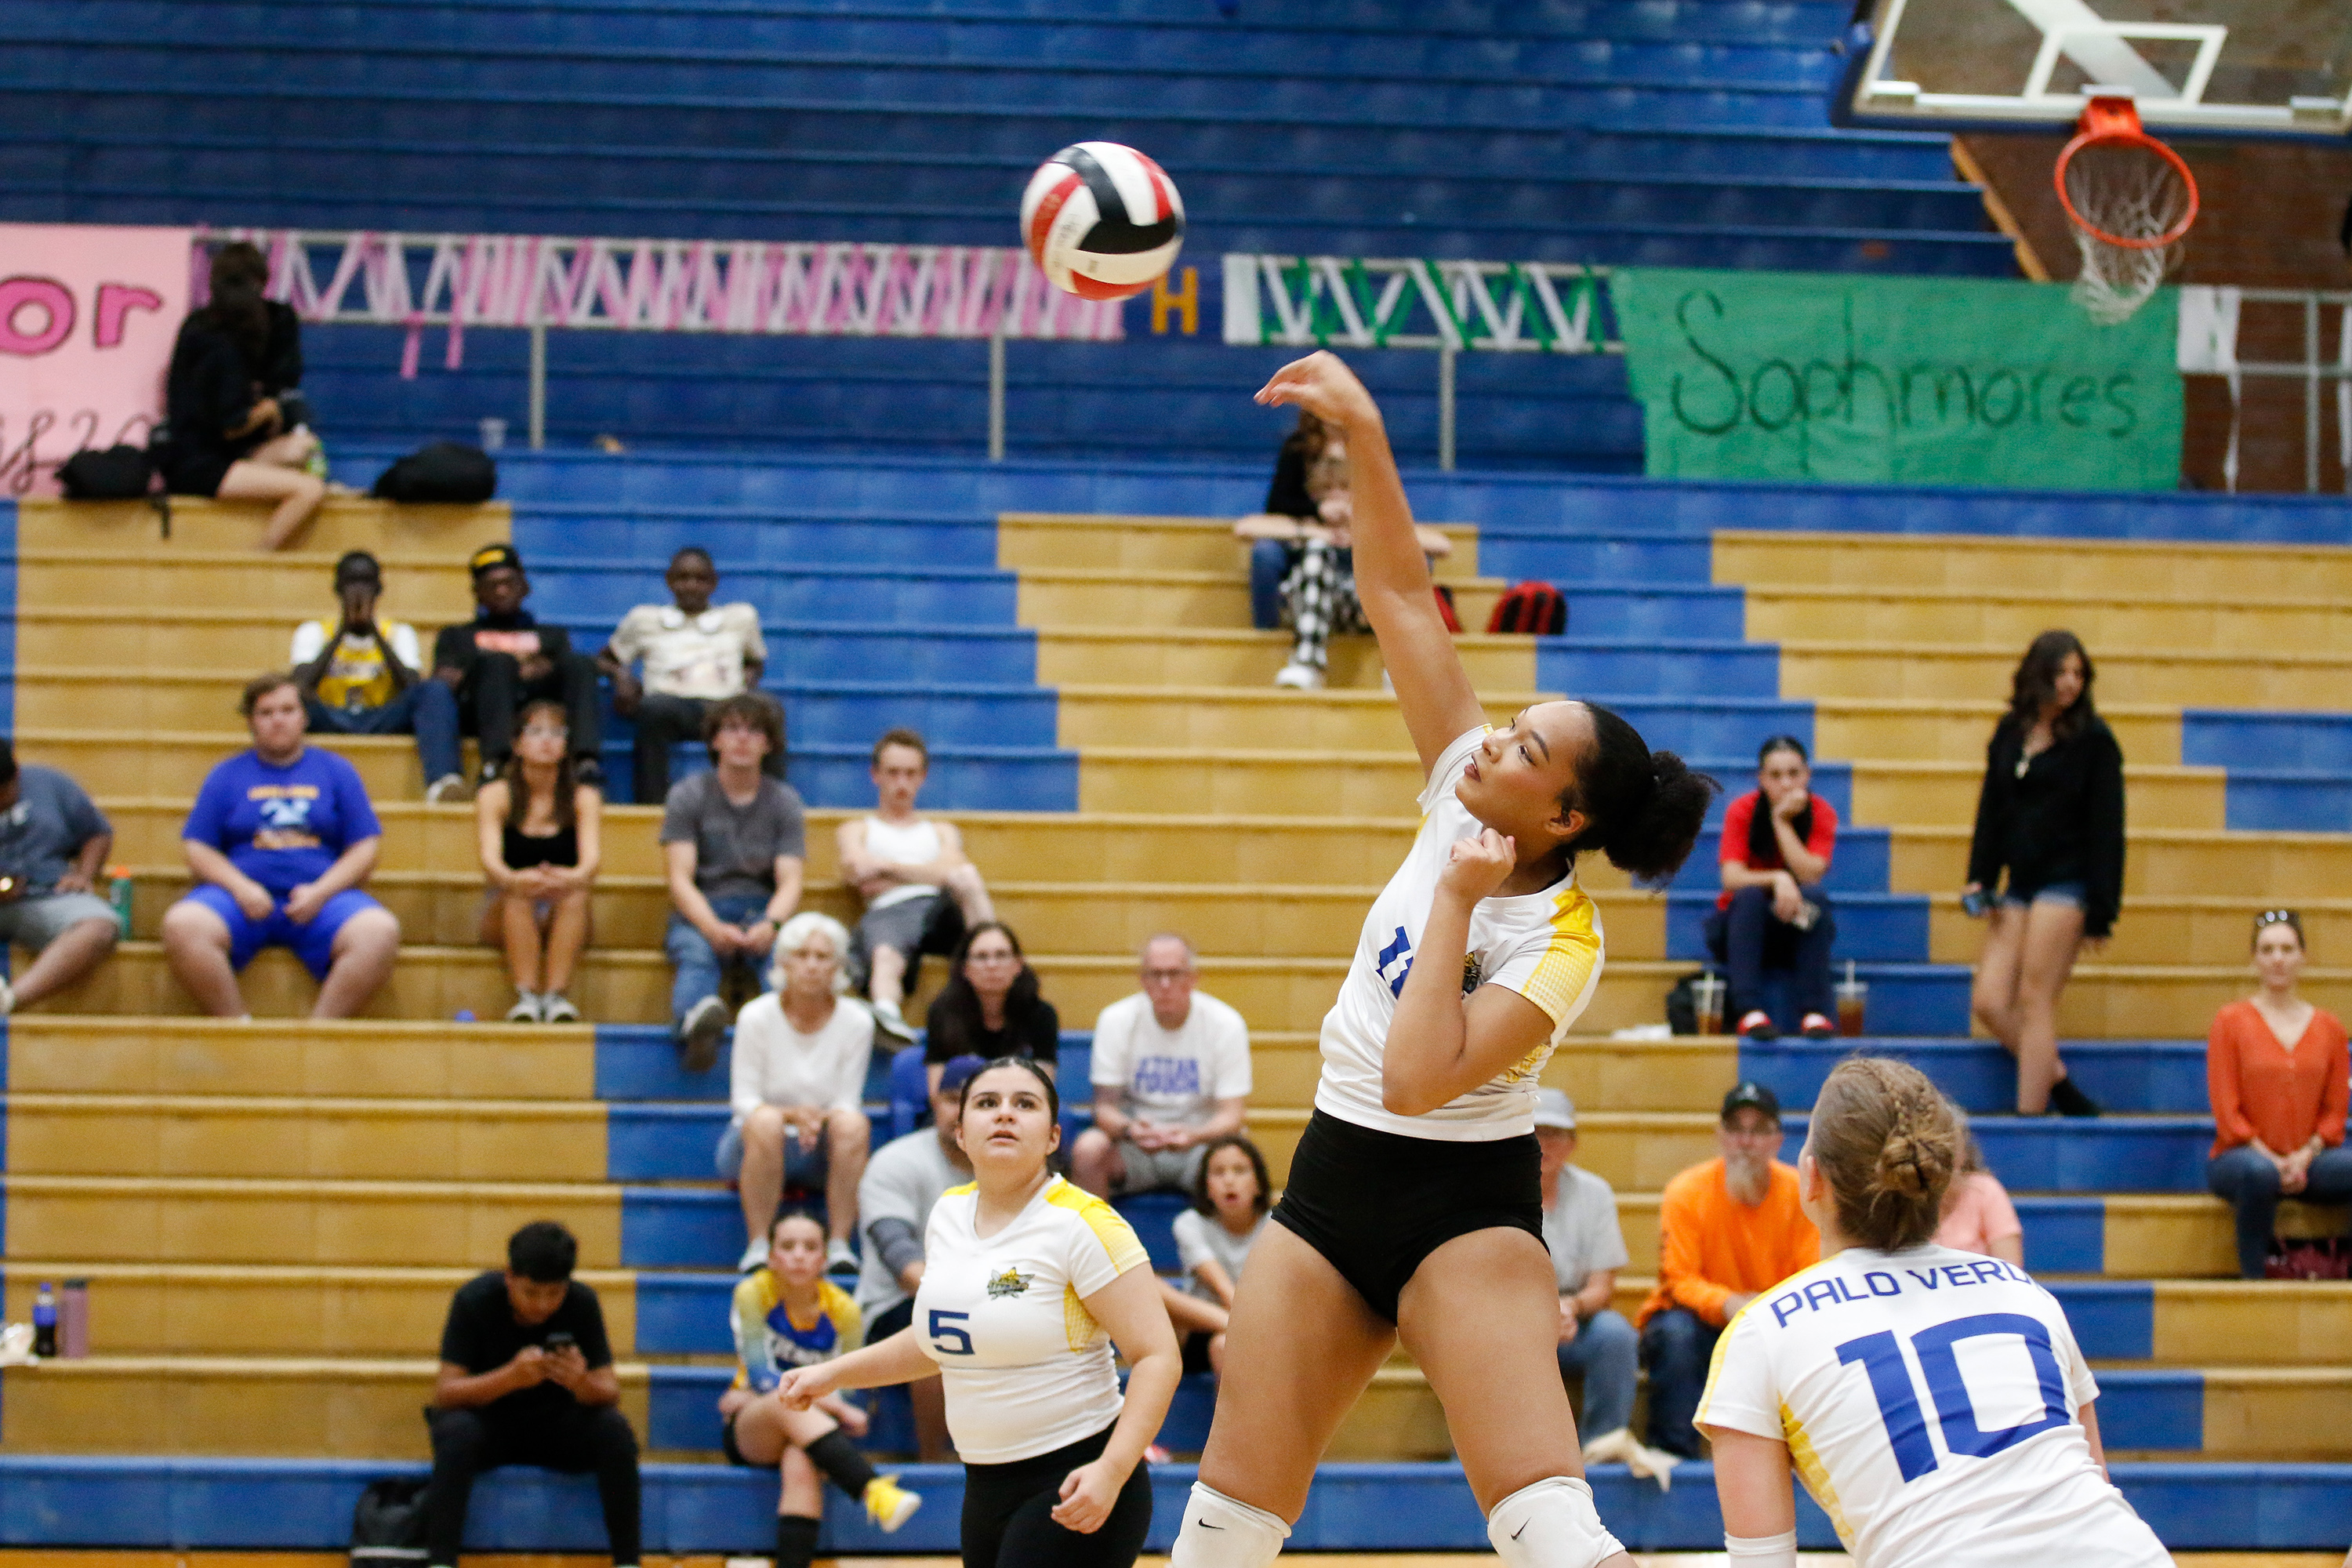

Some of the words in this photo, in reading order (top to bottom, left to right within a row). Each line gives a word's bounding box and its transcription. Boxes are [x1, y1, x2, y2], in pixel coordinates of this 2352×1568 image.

[1670, 289, 2139, 474] Sophmores
[928, 1308, 976, 1356] 5
[1769, 1271, 1902, 1328] PALO
[1835, 1312, 2071, 1483] 10
